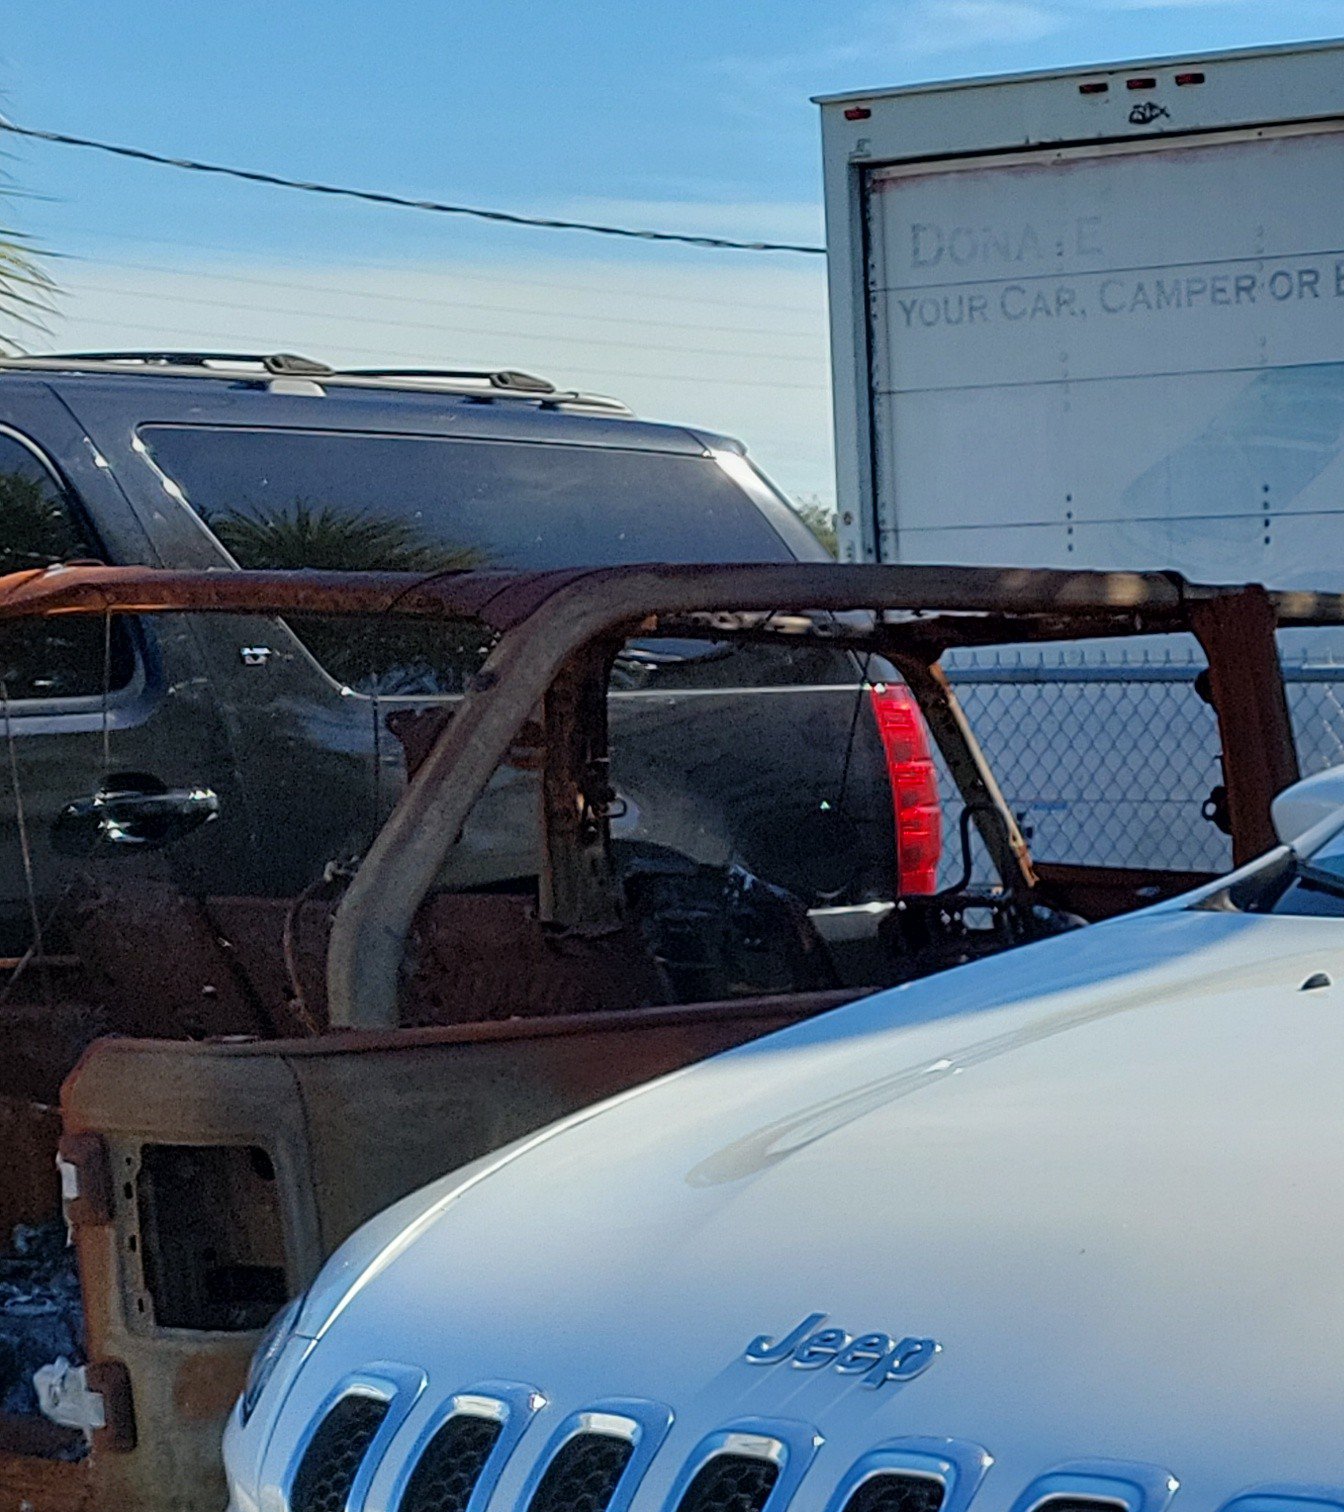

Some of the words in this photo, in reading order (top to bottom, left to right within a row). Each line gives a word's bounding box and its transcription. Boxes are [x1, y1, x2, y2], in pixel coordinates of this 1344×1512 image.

[898, 295, 989, 327] YOUR
[1100, 273, 1256, 314] CAMPER
[1268, 268, 1320, 301] OR
[745, 1312, 942, 1390] Jeep
